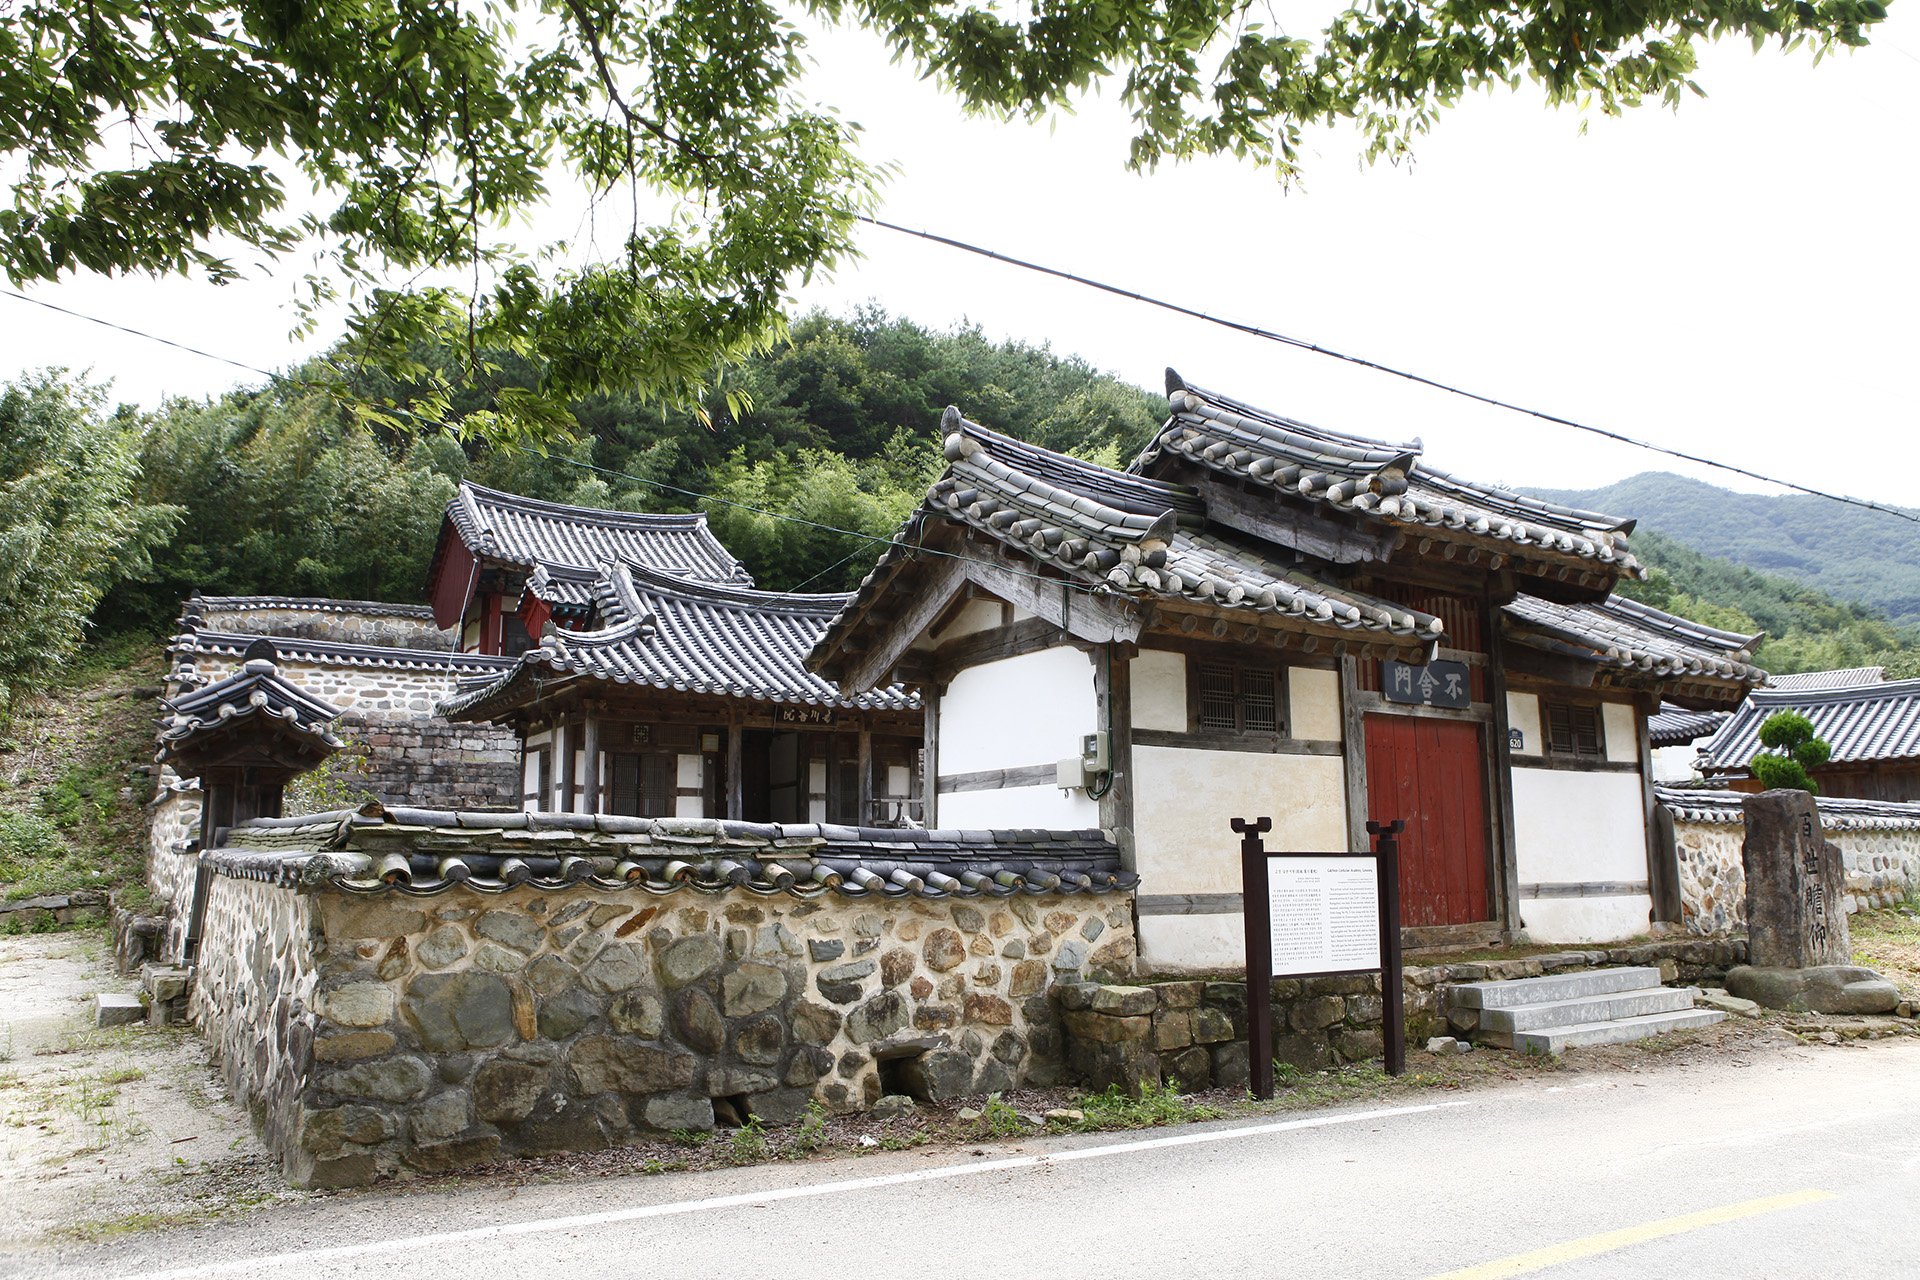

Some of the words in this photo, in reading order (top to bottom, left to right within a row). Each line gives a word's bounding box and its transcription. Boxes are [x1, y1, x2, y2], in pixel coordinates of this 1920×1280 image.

[1509, 738, 1522, 748] 620
[1799, 811, 1827, 956] 百世瞻仰
